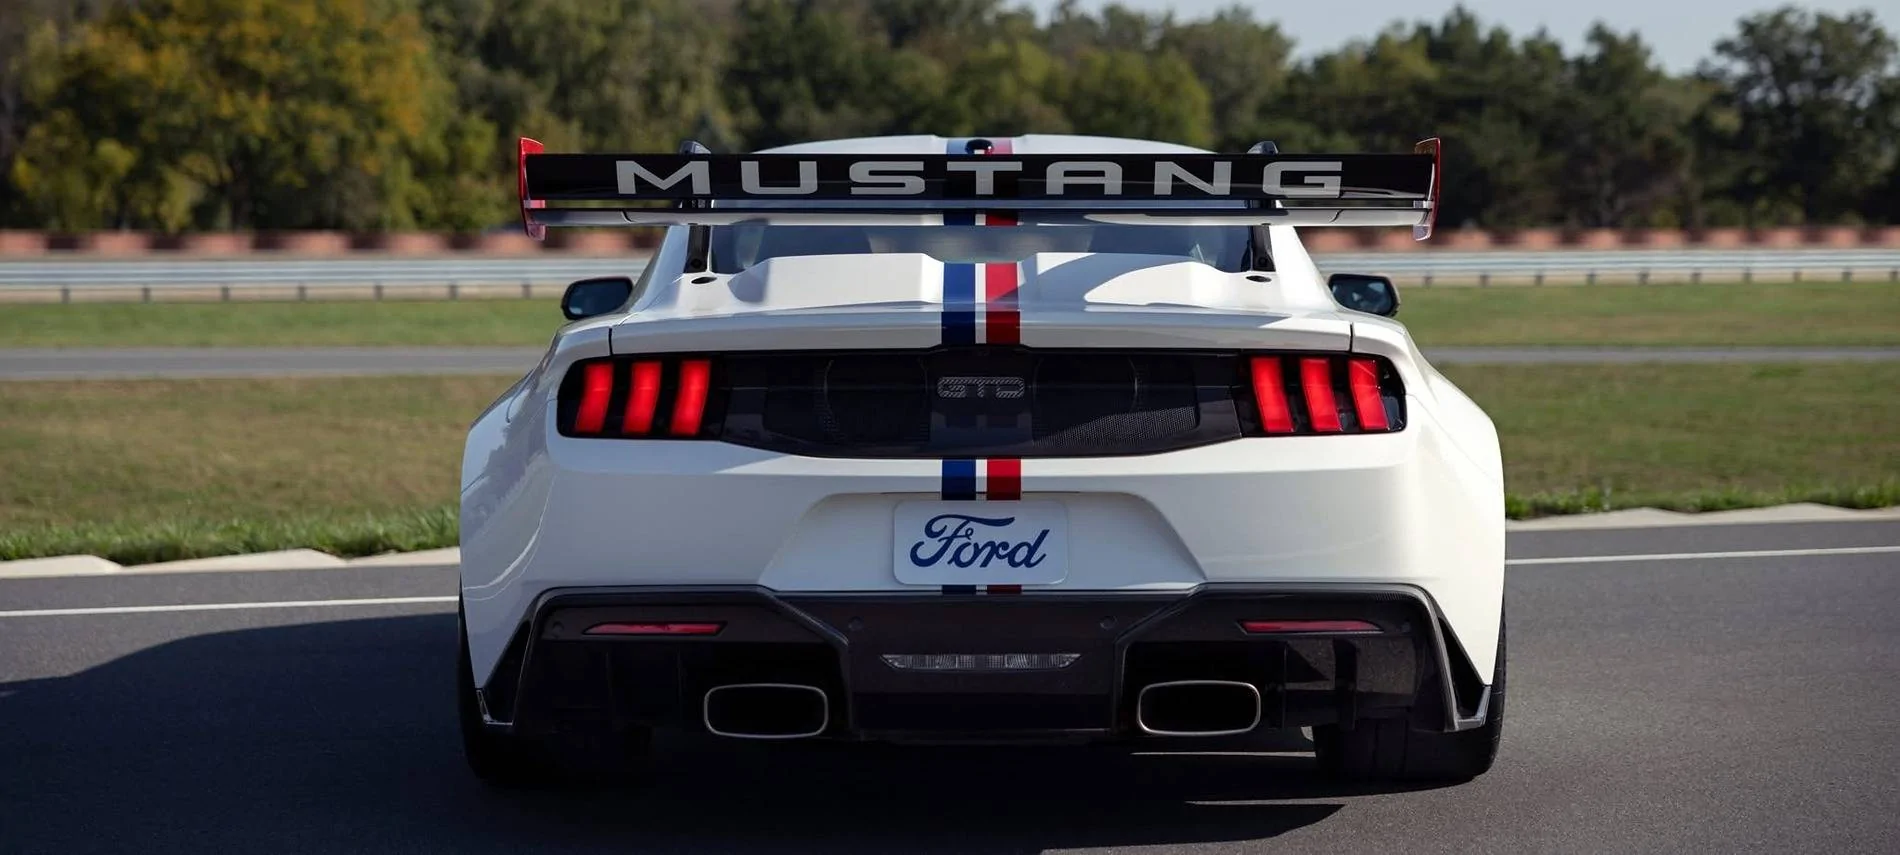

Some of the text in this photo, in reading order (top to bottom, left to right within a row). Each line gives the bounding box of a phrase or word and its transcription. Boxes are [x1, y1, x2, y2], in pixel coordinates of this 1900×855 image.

[615, 160, 1343, 198] MUSTANG
[937, 376, 1025, 398] GTD
[909, 514, 1050, 568] Ford
